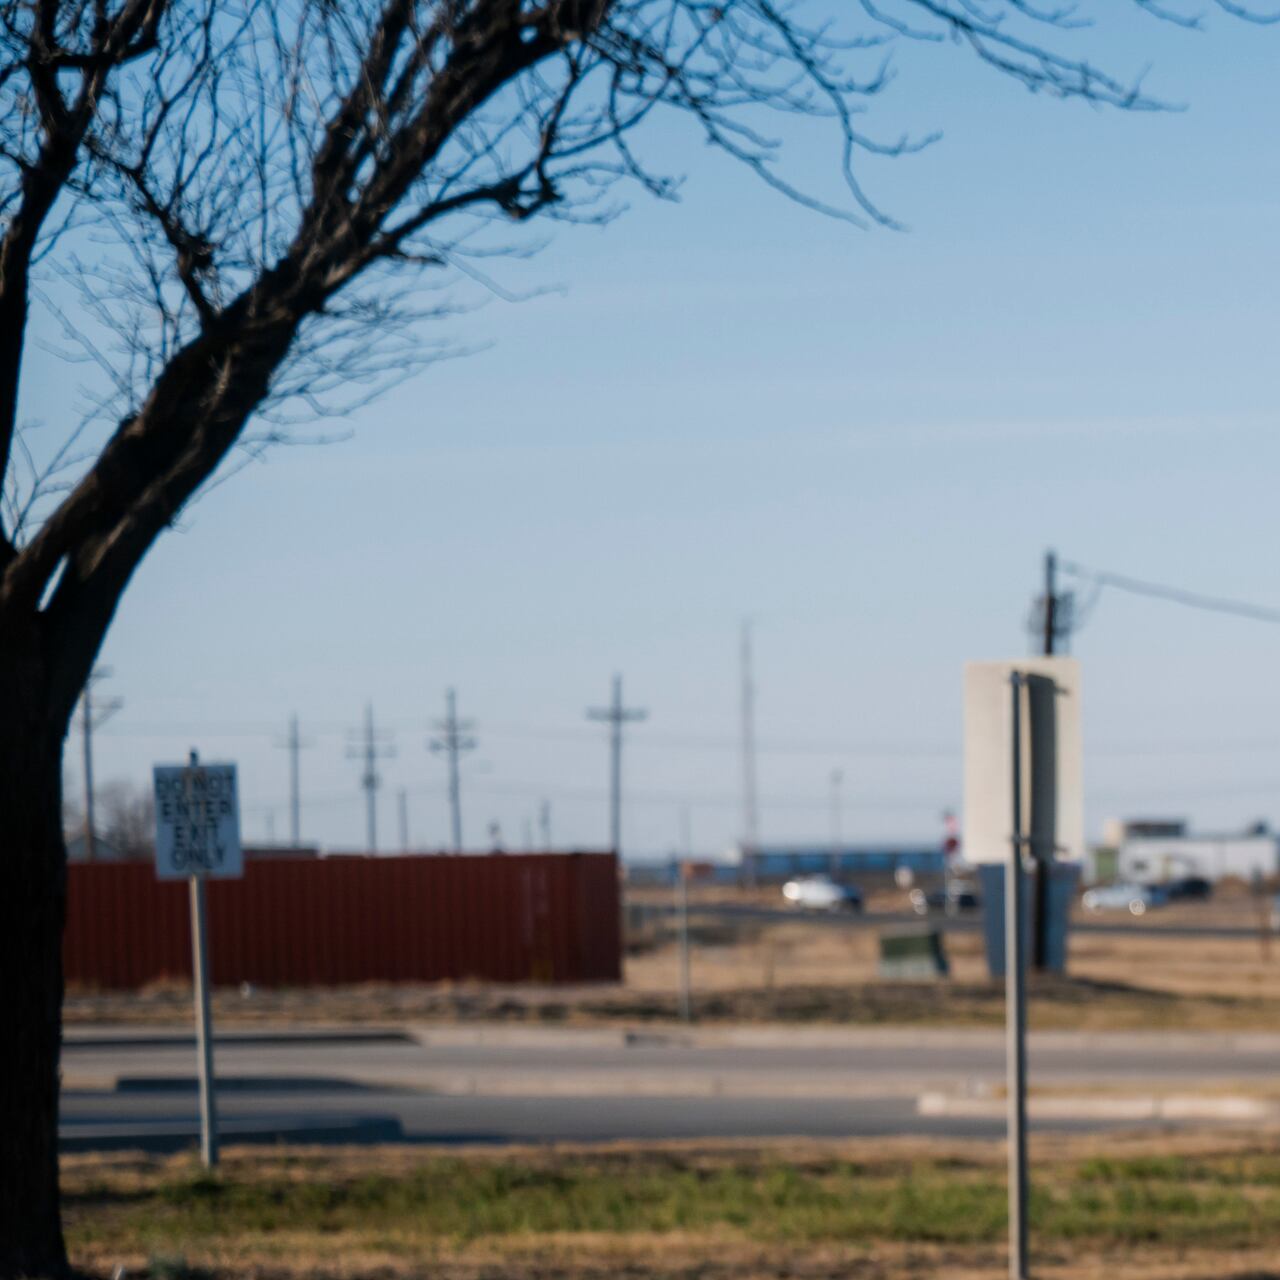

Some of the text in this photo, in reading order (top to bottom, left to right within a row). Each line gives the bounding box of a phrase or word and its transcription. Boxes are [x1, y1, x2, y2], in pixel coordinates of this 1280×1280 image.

[156, 773, 234, 799] DO NOT
[161, 801, 232, 819] ENTER
